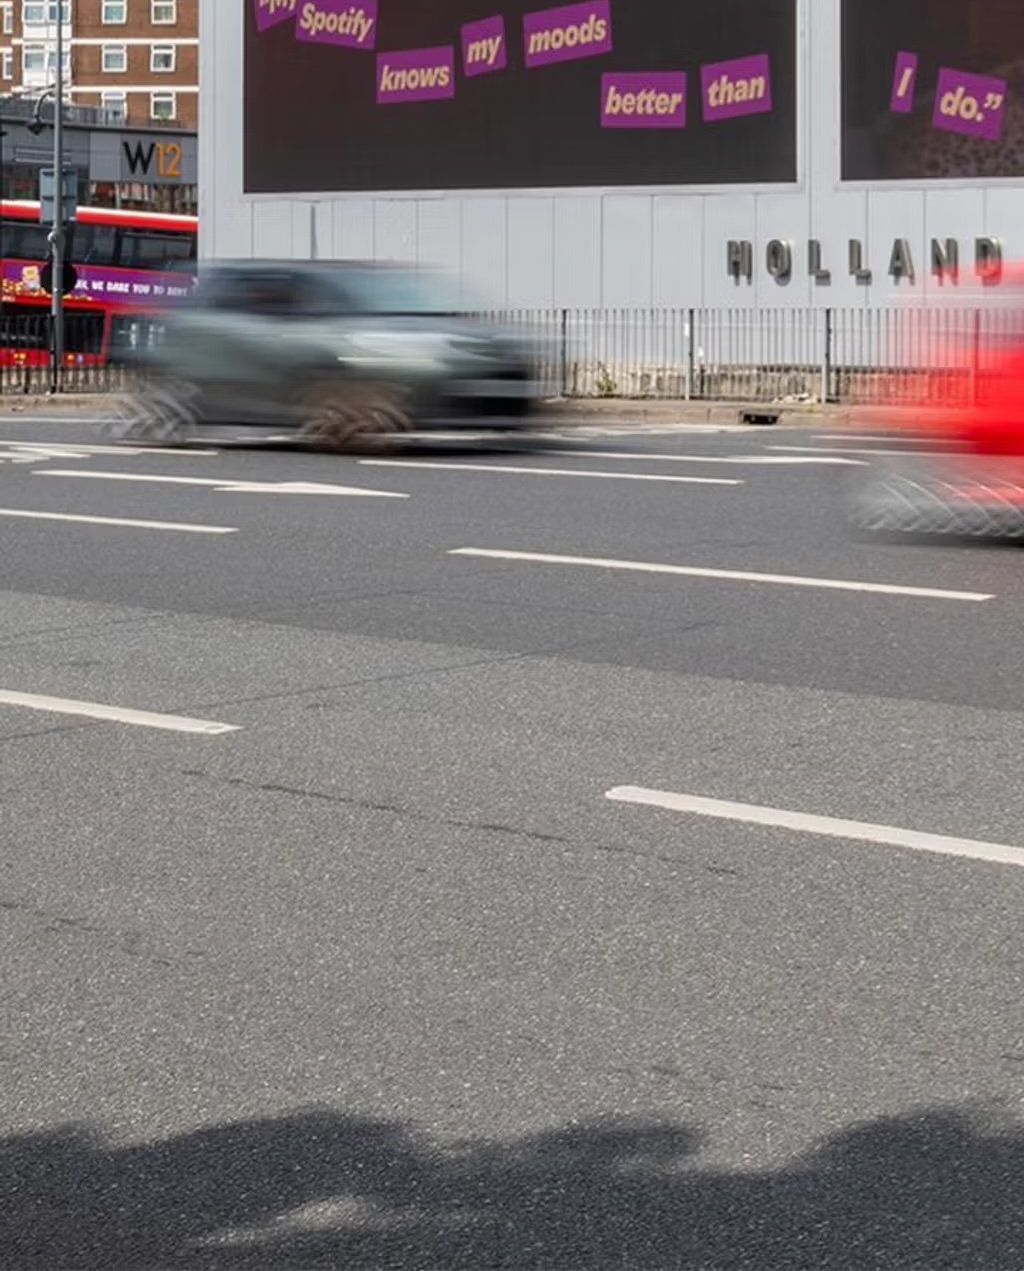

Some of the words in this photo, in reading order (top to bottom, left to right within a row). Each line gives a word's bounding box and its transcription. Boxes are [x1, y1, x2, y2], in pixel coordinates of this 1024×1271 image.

[300, 2, 374, 43] Spotify
[380, 65, 450, 92] knows
[467, 35, 502, 65] my
[528, 13, 607, 55] moods
[605, 85, 682, 115] better
[707, 75, 765, 107] than
[897, 68, 913, 97] I
[940, 86, 1003, 122] do.”
[123, 141, 182, 177] W12
[727, 238, 1003, 281] HOLLAND
